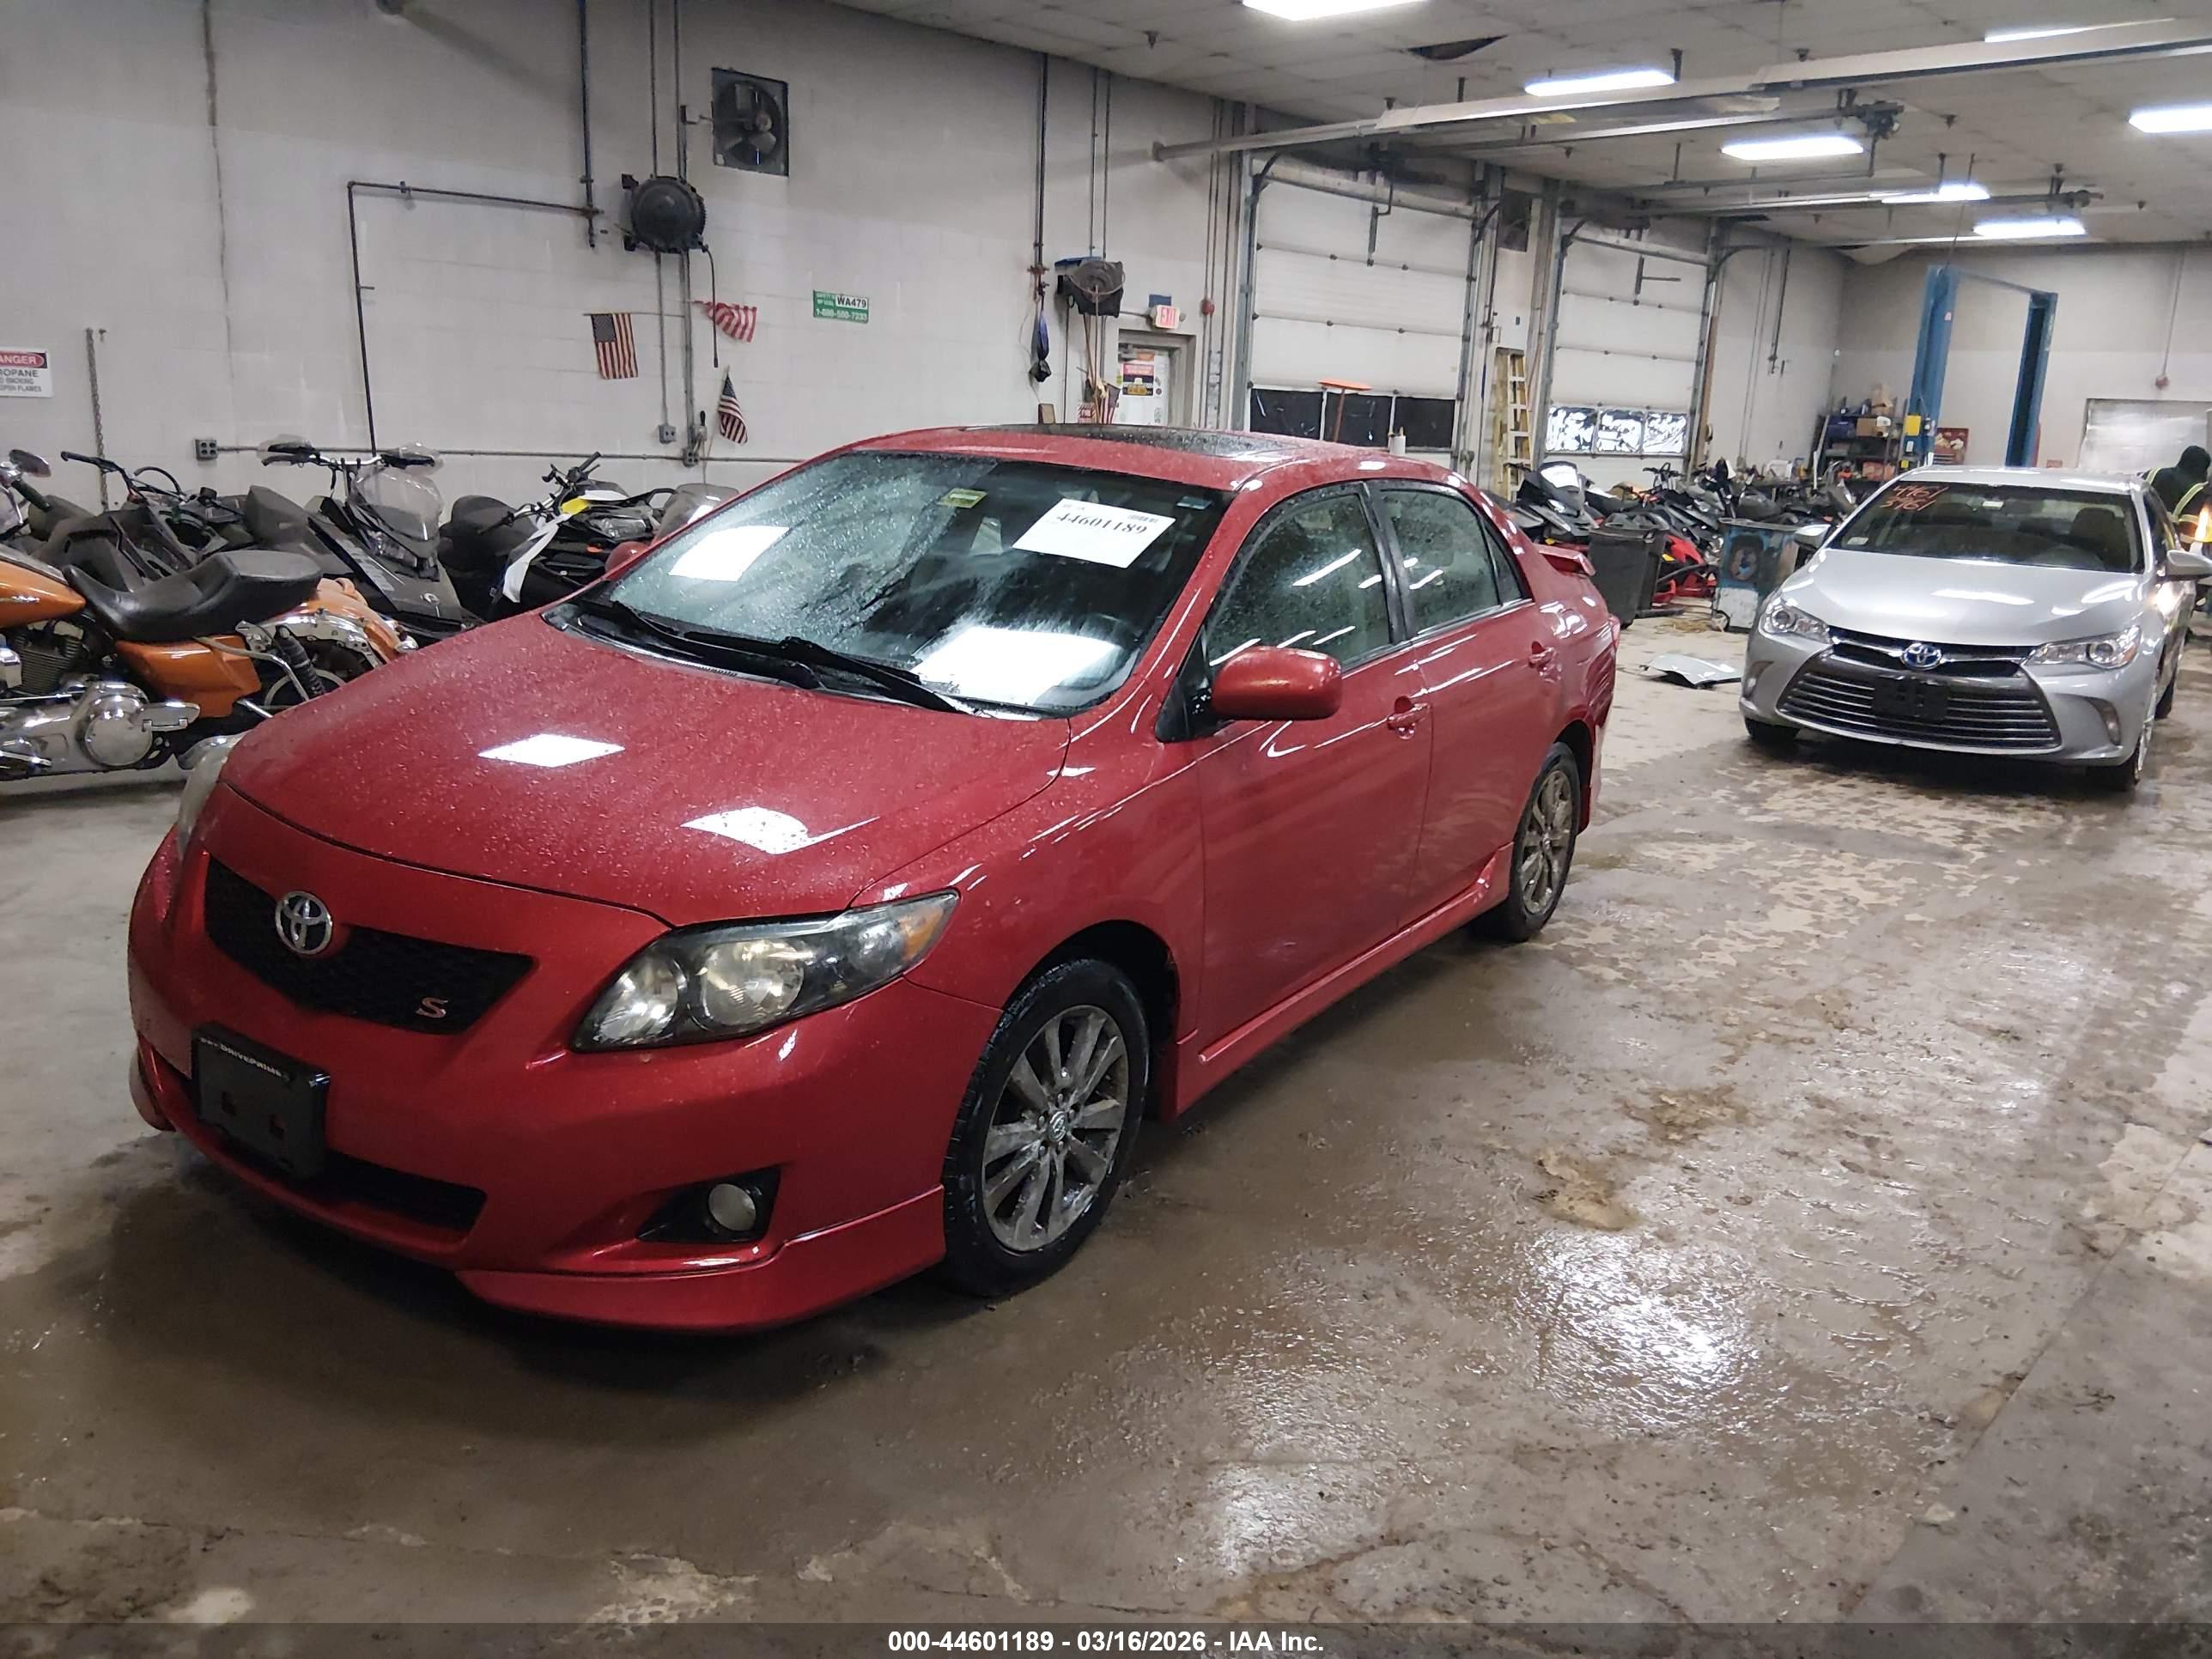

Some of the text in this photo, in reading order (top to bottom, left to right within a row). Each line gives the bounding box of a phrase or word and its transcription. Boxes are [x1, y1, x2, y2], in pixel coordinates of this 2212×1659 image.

[837, 296, 866, 308] WA479
[1160, 307, 1176, 326] EXIT
[1055, 513, 1147, 534] 44601189
[416, 997, 448, 1018] S
